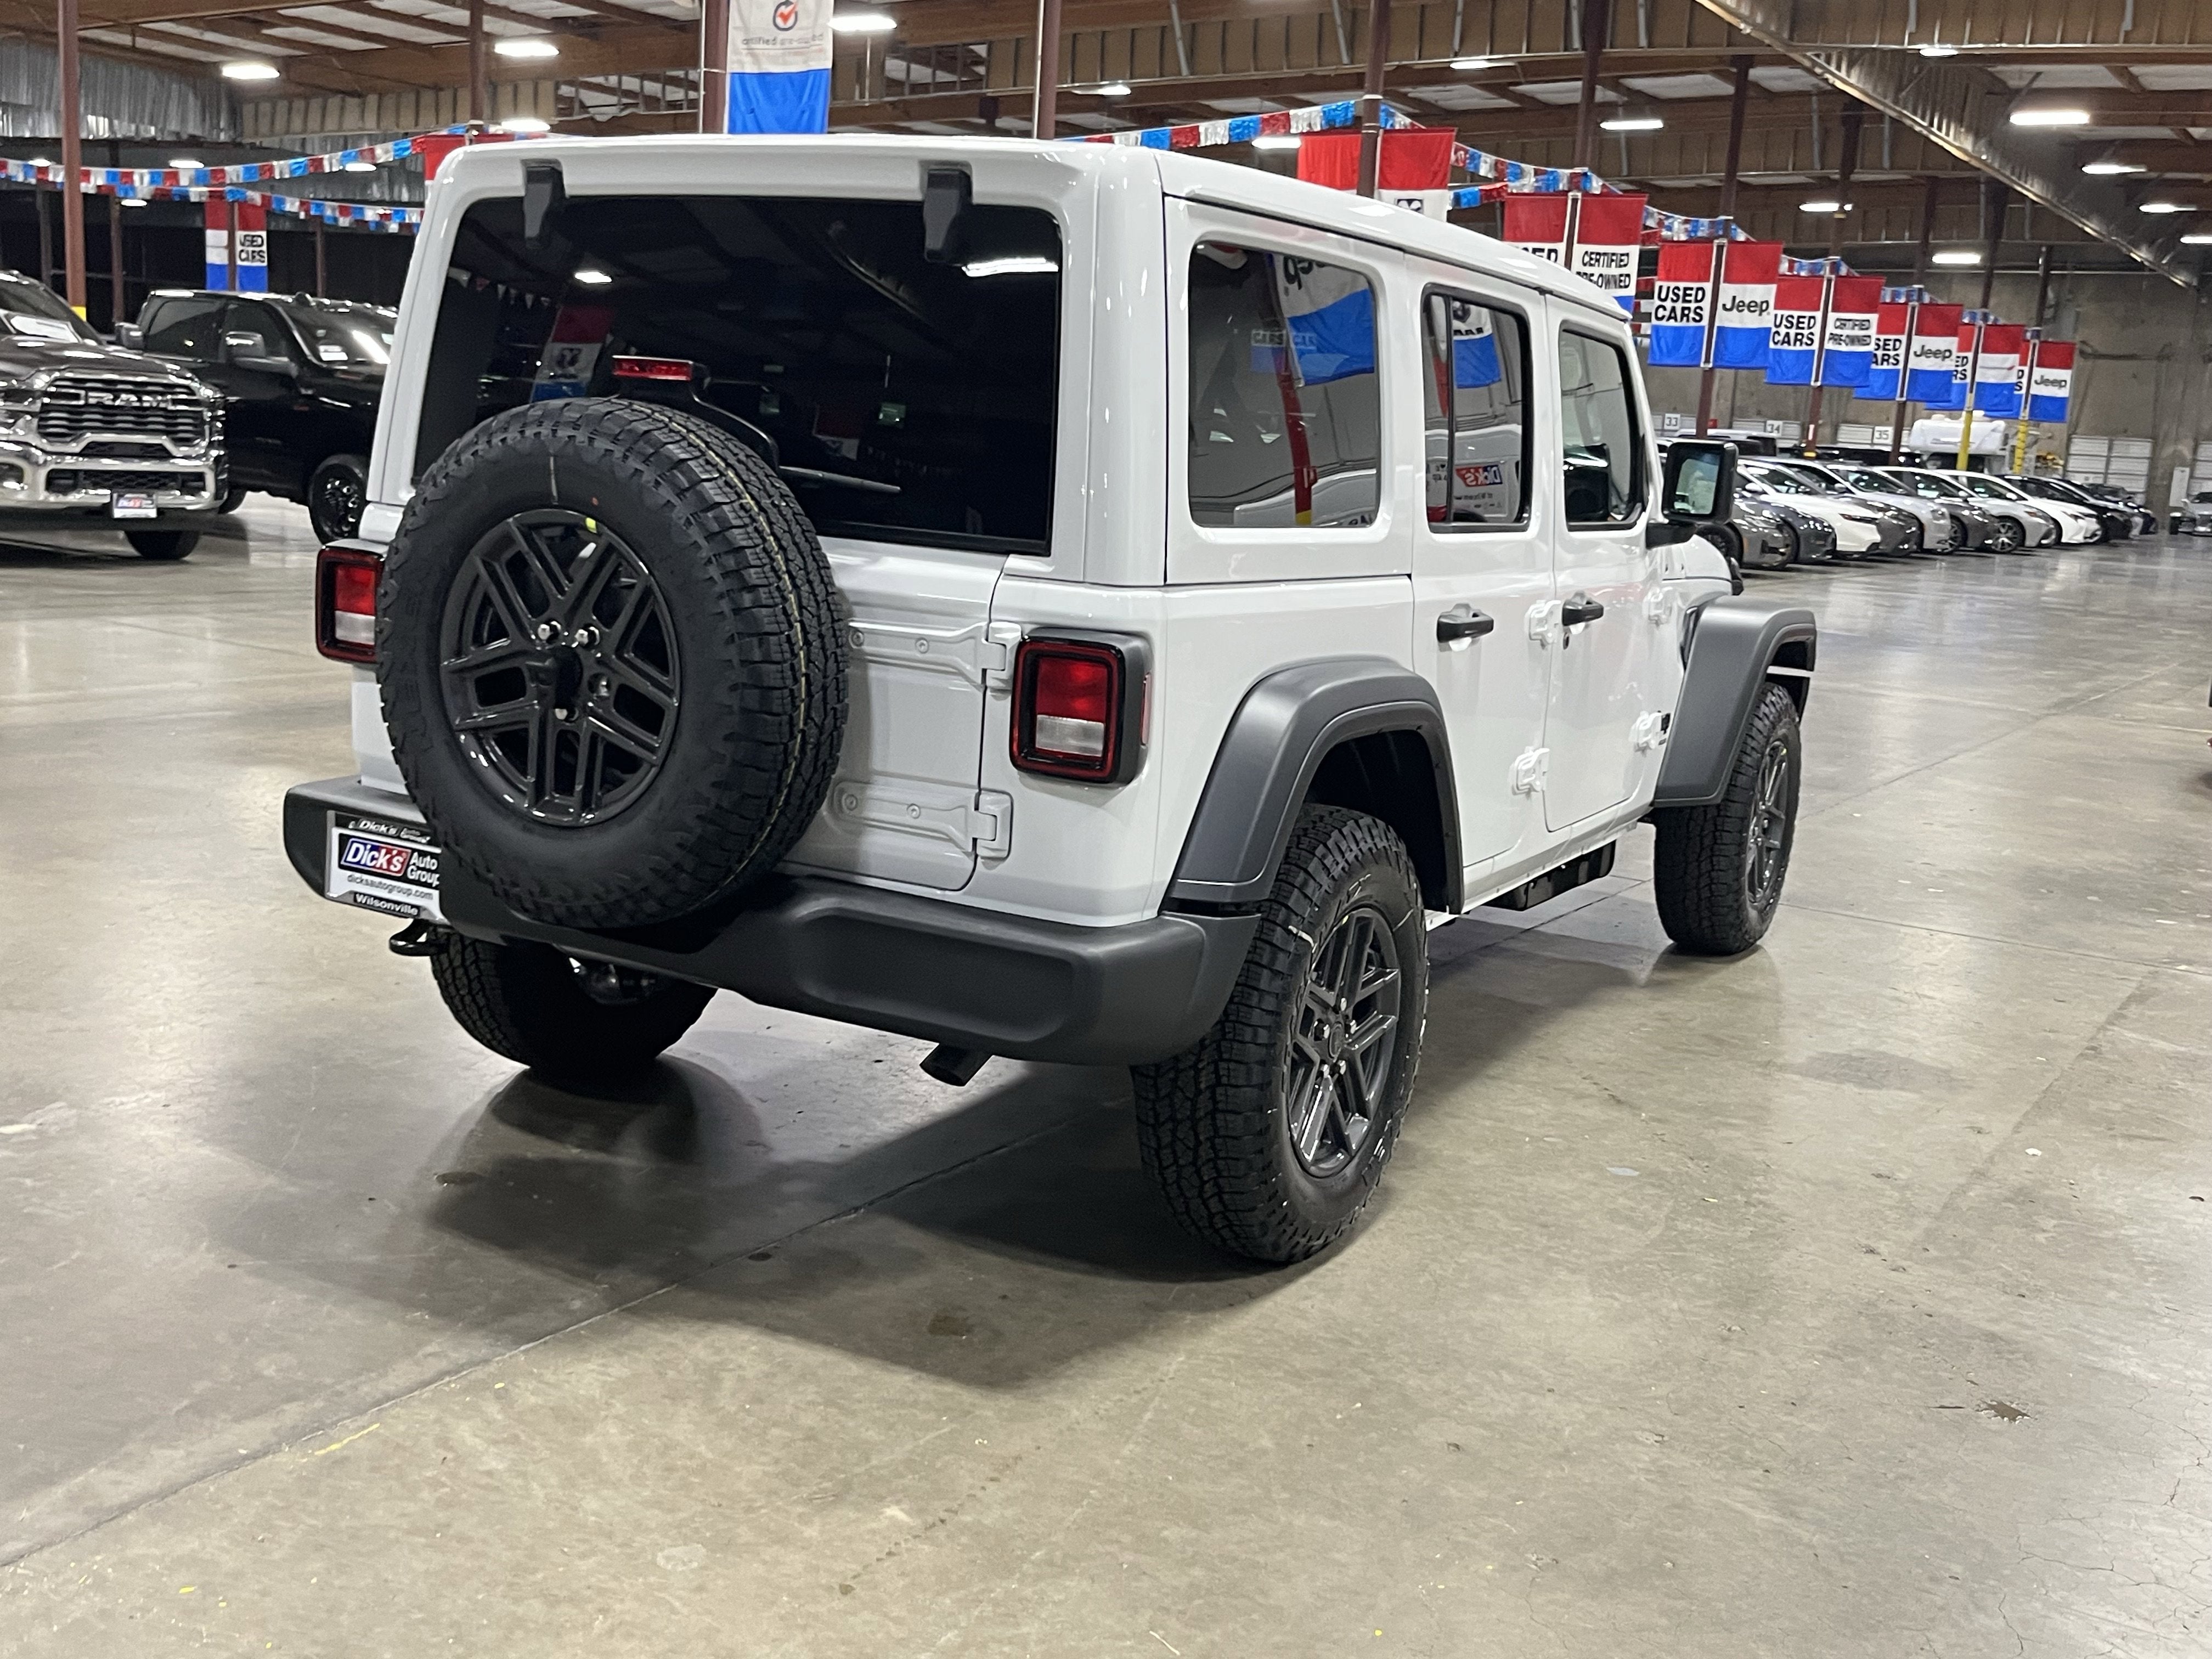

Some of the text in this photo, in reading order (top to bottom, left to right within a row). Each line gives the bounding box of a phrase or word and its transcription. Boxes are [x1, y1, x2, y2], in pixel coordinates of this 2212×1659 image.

[1582, 251, 1629, 268] CERTIFIED
[1657, 285, 1706, 303] USED
[1654, 304, 1703, 323] CARS
[1722, 295, 1770, 317] Jeep
[1774, 313, 1816, 330] USED
[1772, 330, 1815, 347] CARS
[1874, 338, 1902, 352] SED
[1872, 353, 1900, 366] ARS
[1914, 345, 1953, 362] Jeep
[2034, 375, 2067, 390] Jeep
[1666, 417, 1678, 426] 33
[1767, 424, 1780, 434] 34
[1876, 430, 1889, 440] 35
[346, 842, 404, 871] Dick's
[410, 851, 438, 870] Auto
[356, 894, 418, 916] Wilsonville
